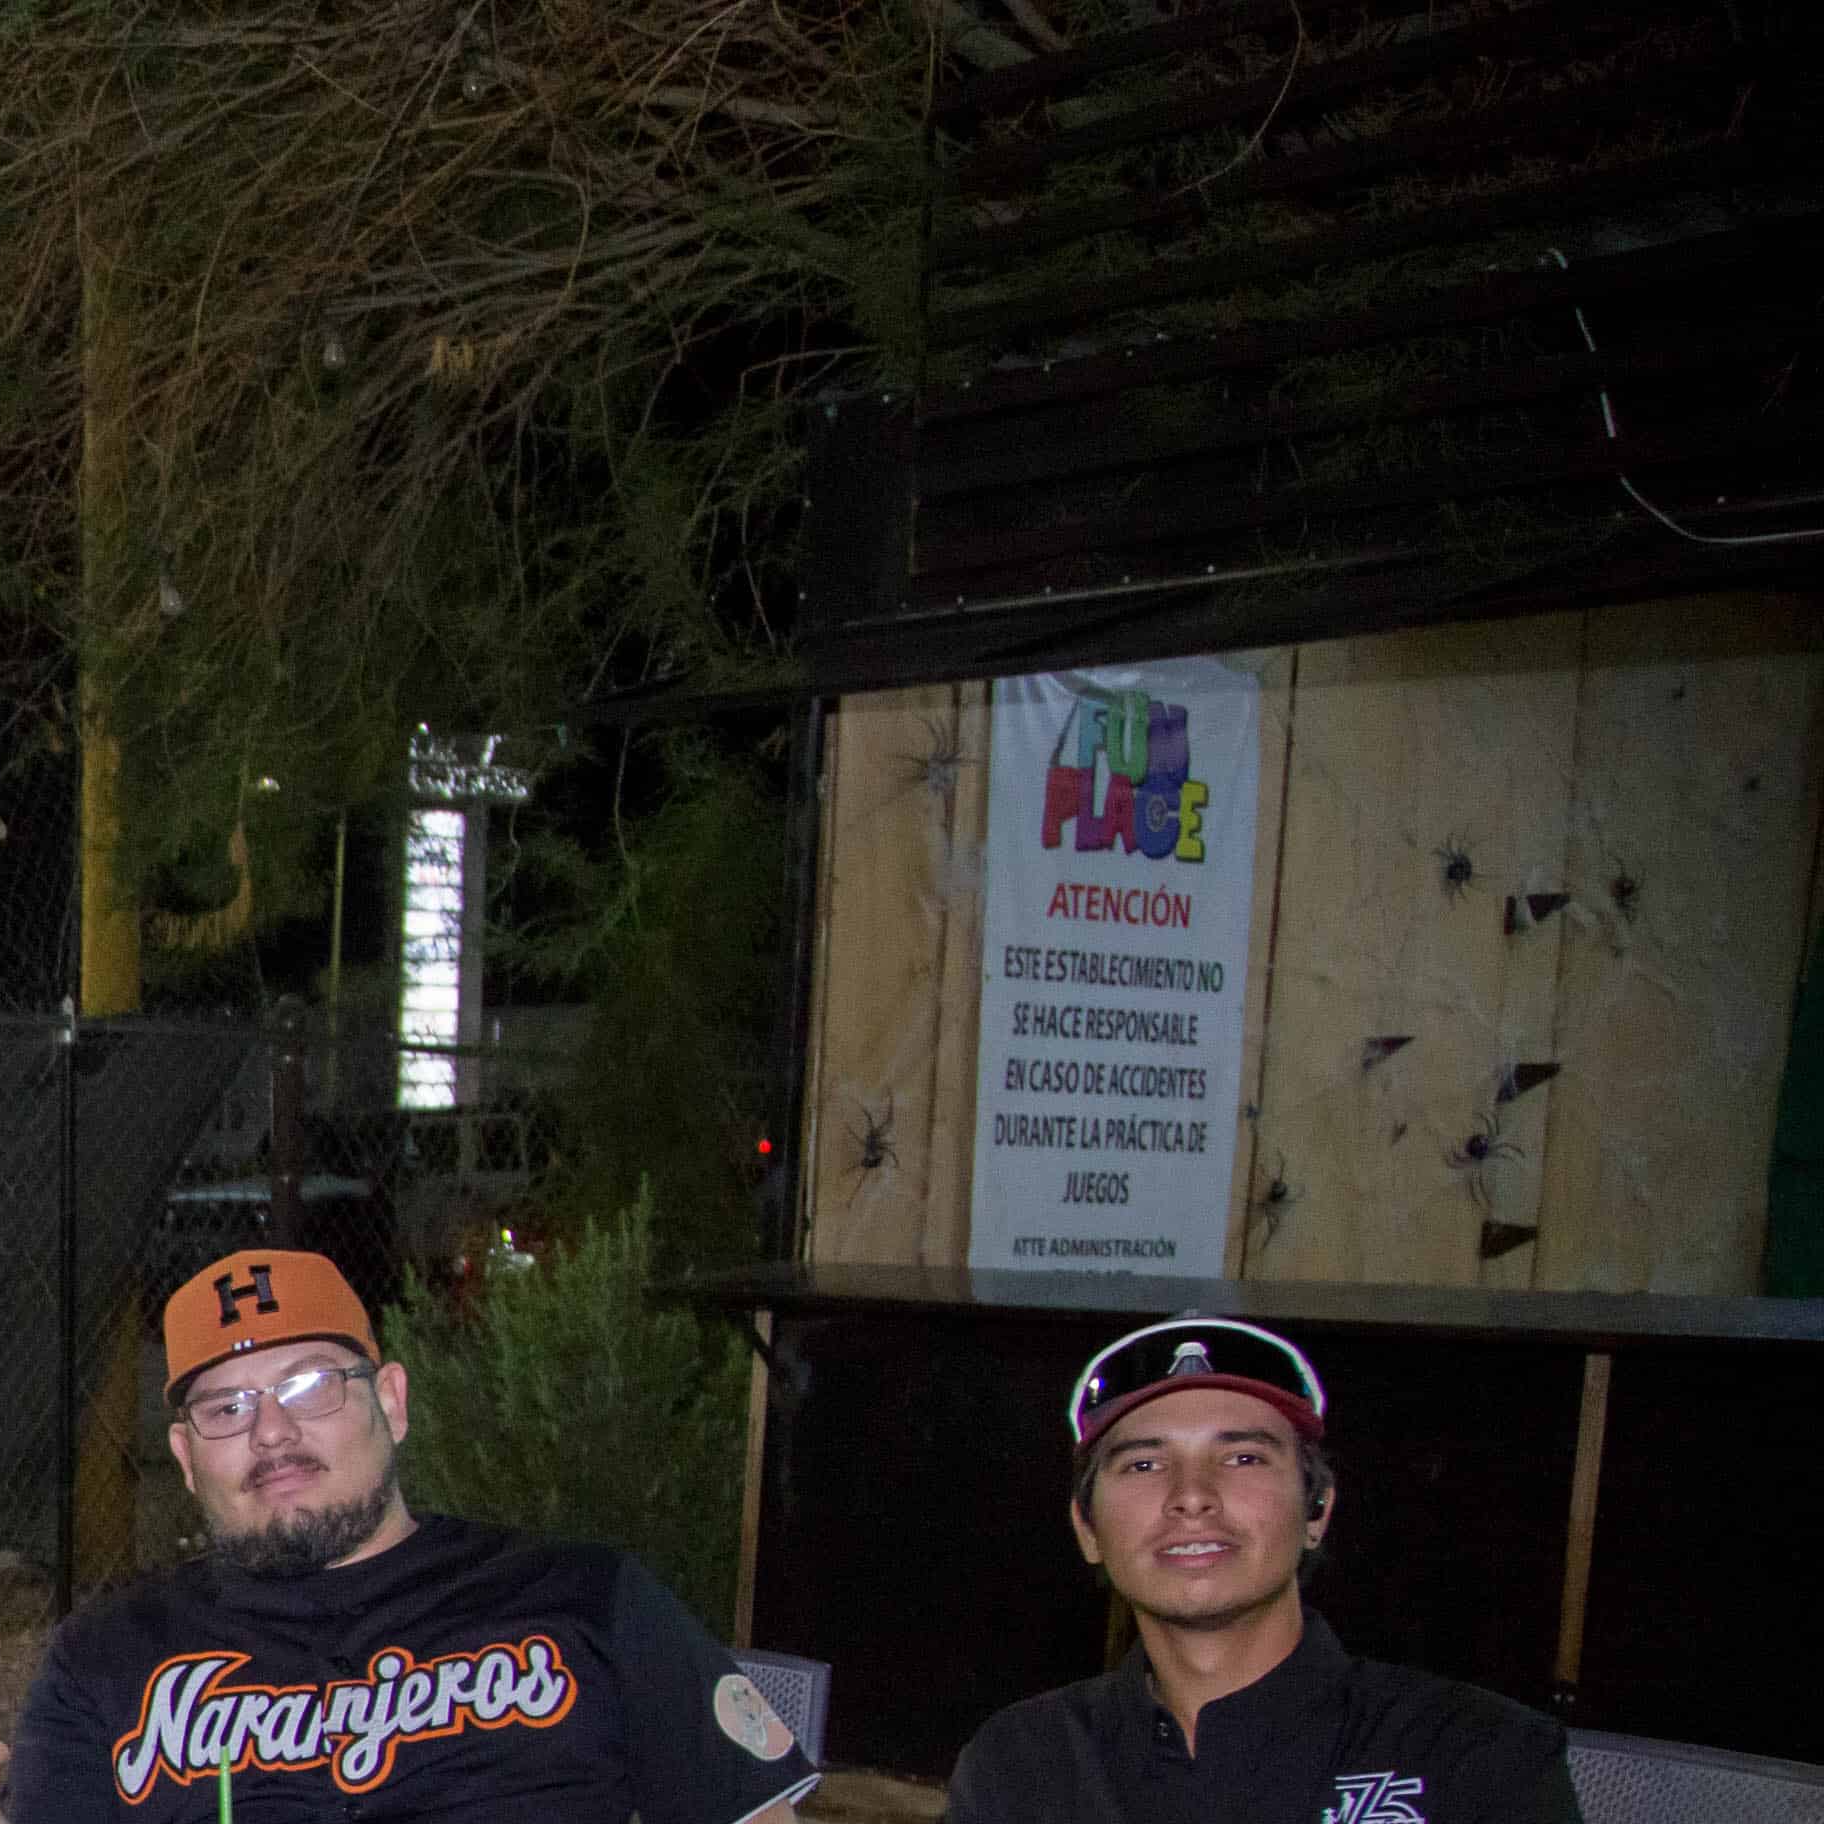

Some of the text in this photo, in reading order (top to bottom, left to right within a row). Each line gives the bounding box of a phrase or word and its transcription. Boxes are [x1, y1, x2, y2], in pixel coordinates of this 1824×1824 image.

[1077, 690, 1189, 785] FUN
[1042, 766, 1208, 864] PLACE
[1046, 883, 1191, 929] ATENCIÓN
[1004, 945, 1225, 993] ESTE ESTABLECIMIENTO NO
[1013, 1001, 1199, 1046] SE HACE RESPONSABLE
[1005, 1058, 1206, 1100] EN CASO DE ACCIDENTES
[994, 1113, 1208, 1153] DURANTE LA PRÁCTICA DE
[1063, 1171, 1130, 1204] JUEGOS
[1052, 1235, 1177, 1258] ADMINISTRACIÓN
[213, 1264, 280, 1329] H
[112, 1636, 575, 1801] Naranjeros
